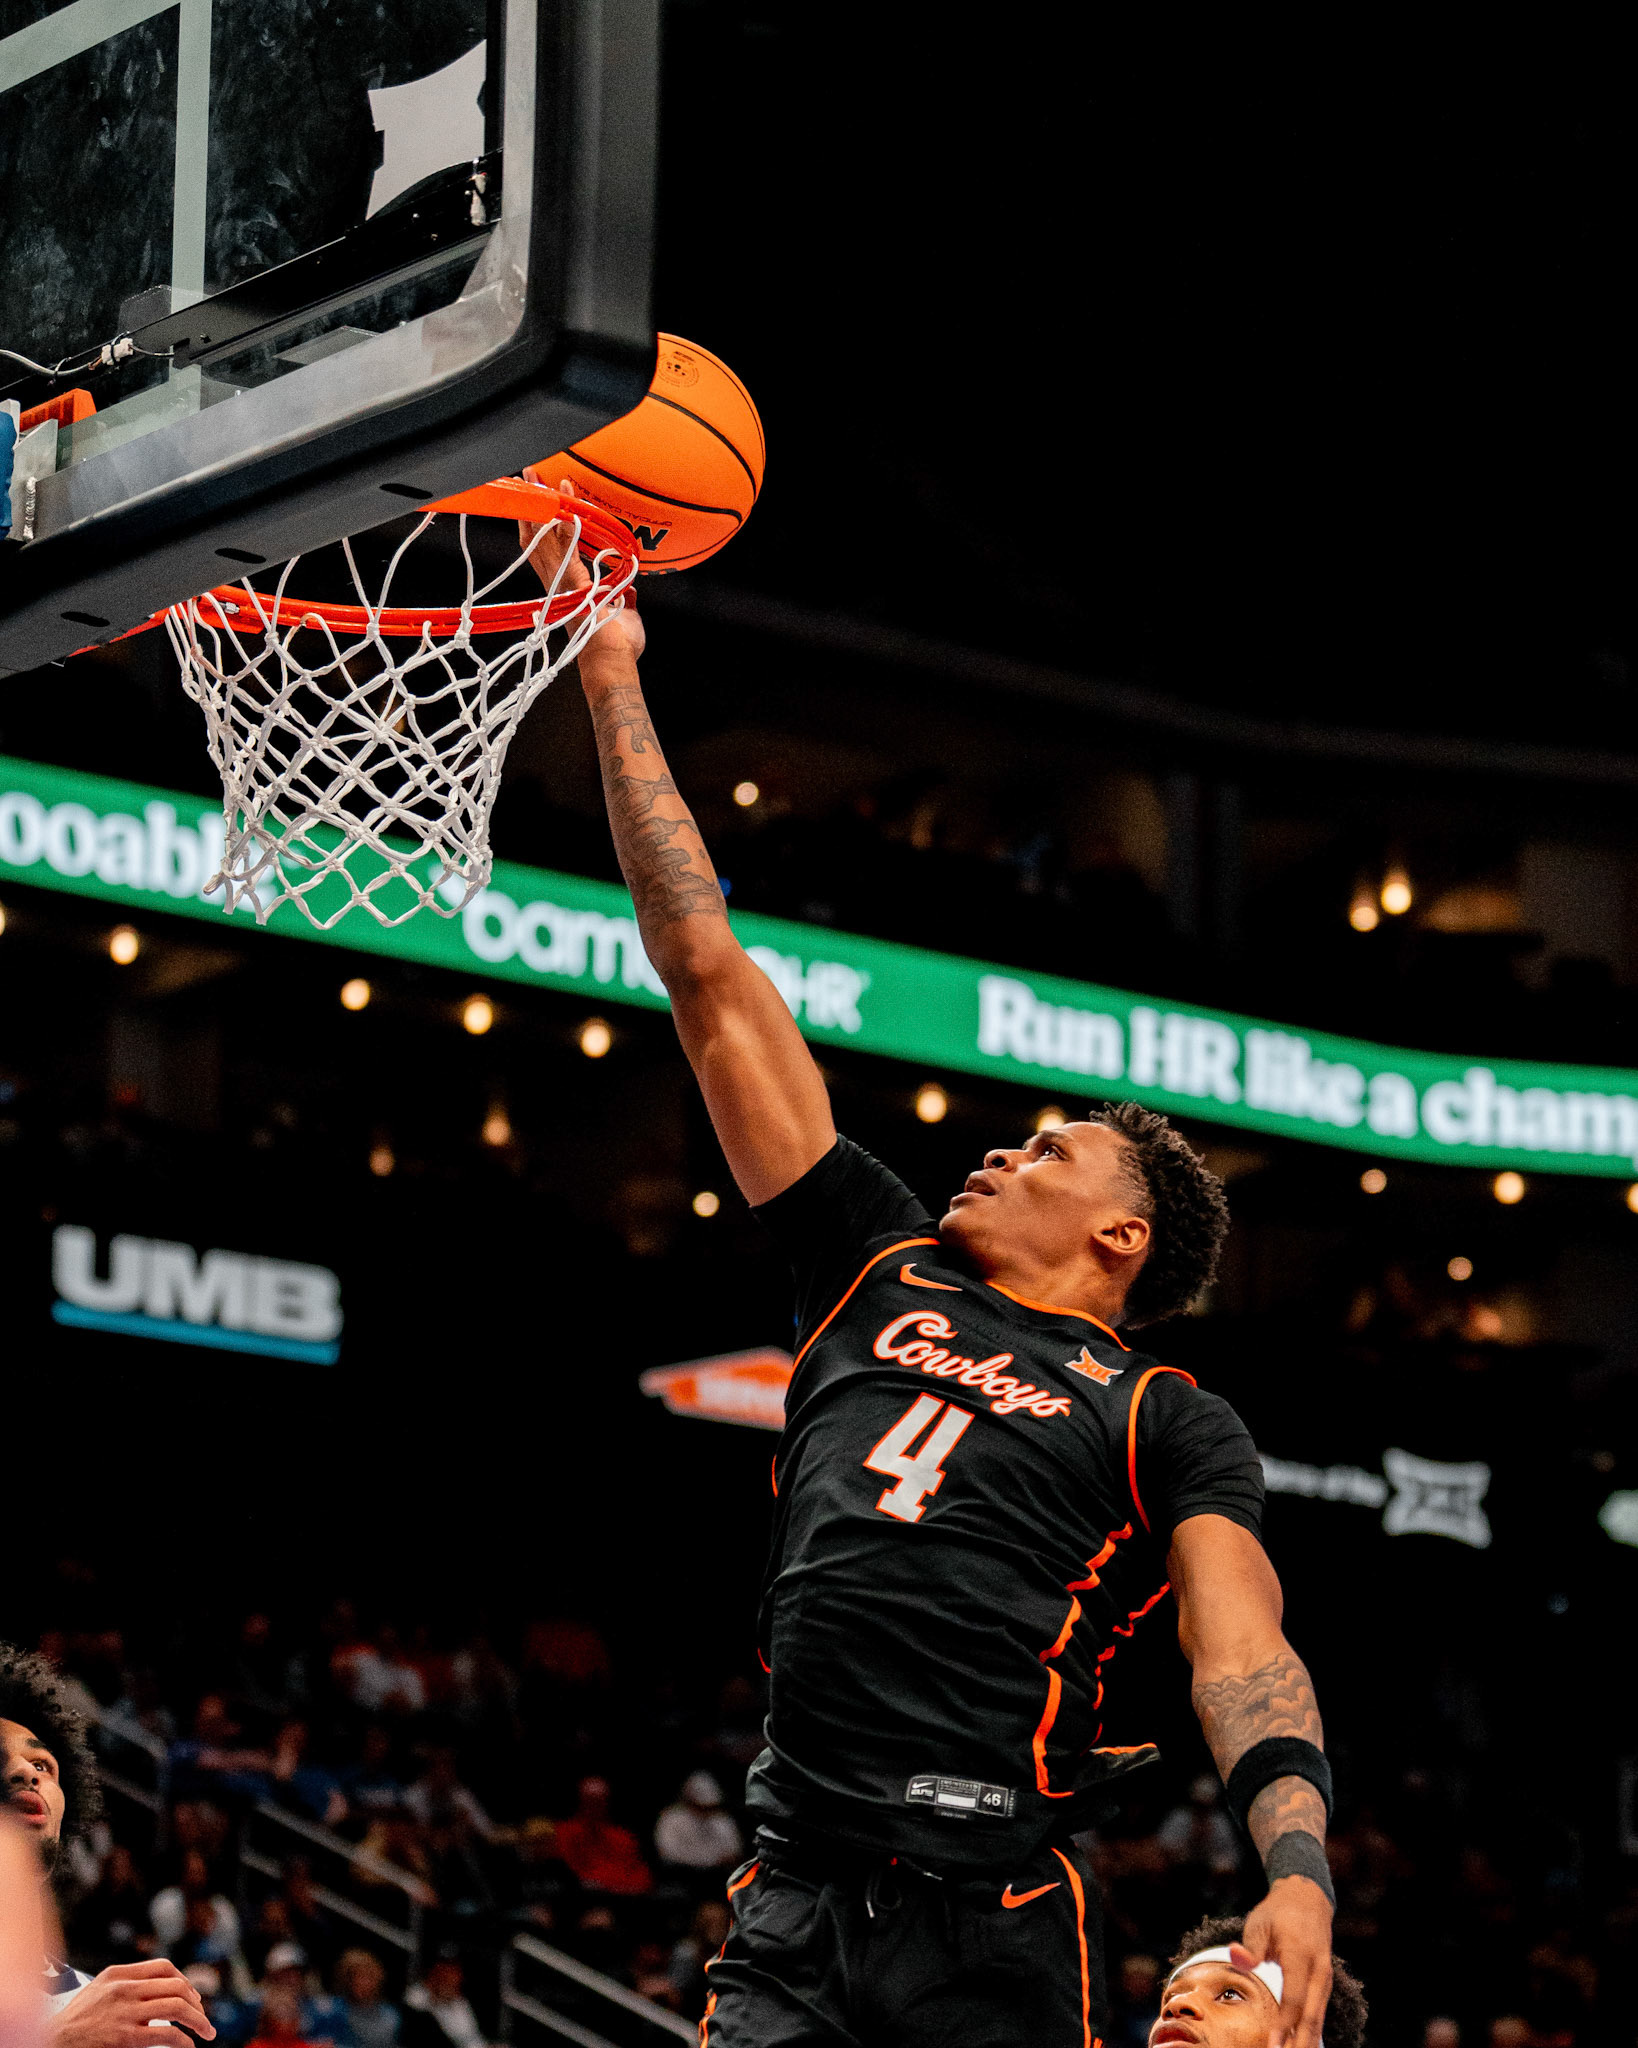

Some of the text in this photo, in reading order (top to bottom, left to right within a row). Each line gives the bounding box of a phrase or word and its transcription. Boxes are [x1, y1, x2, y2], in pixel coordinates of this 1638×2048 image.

[567, 474, 591, 496] BALL
[624, 511, 673, 527] OFFICIAL
[977, 974, 1638, 1172] Run HR like a cham
[52, 1224, 343, 1343] UMB
[873, 1310, 1072, 1417] Cowboys
[863, 1392, 975, 1523] 4
[982, 1792, 1001, 1806] 46
